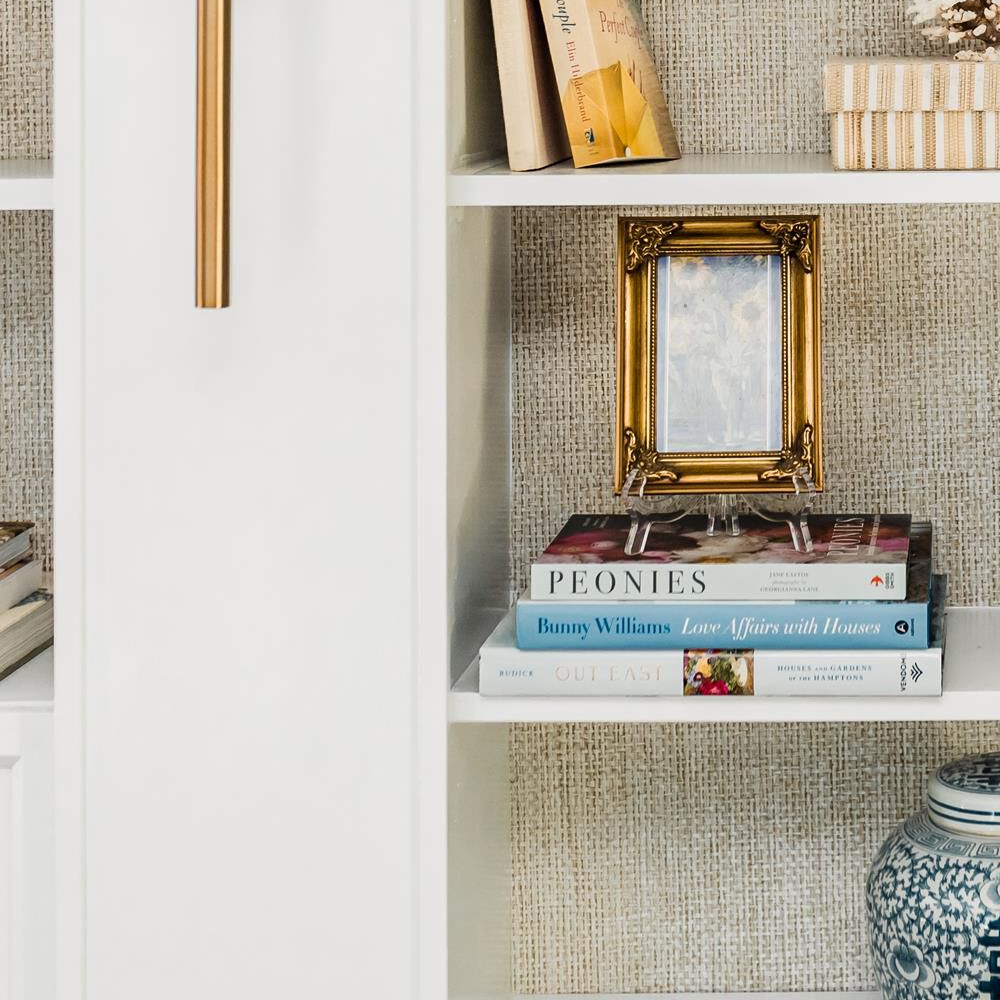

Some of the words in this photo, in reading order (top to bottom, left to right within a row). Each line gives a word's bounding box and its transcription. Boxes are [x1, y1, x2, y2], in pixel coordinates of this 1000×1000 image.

[566, 41, 576, 62] Elin
[570, 64, 591, 123] Hilderbrand
[827, 517, 865, 556] PEONIES
[548, 569, 706, 595] PEONIES
[538, 617, 590, 640] Bunny
[595, 617, 671, 635] Williams
[681, 617, 720, 635] Love
[725, 617, 780, 641] Affairs
[783, 617, 821, 635] with
[822, 617, 881, 635] Houses
[554, 664, 596, 682] OUT
[608, 664, 663, 682] EAST
[777, 664, 812, 672] HOUSES
[830, 664, 872, 672] GARDENS
